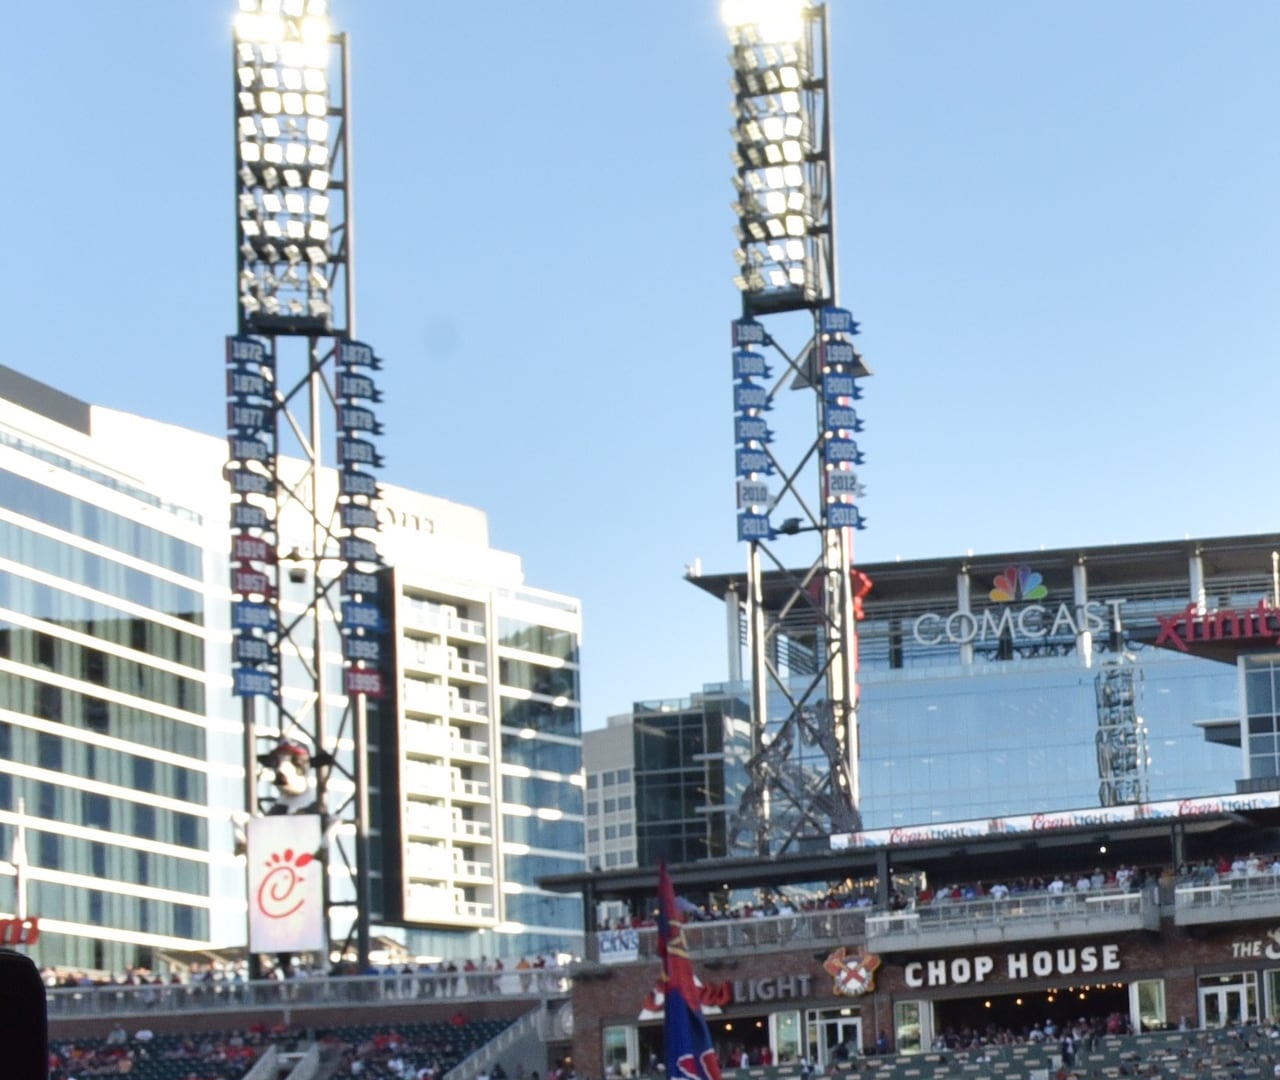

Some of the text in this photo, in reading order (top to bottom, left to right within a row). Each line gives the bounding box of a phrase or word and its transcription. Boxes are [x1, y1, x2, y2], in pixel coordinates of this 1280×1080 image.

[831, 475, 857, 491] 2012
[912, 599, 1127, 646] COMCAST
[1232, 941, 1263, 958] THE
[905, 944, 1121, 988] CHOP HOUSE
[733, 973, 812, 1003] LIGHT
